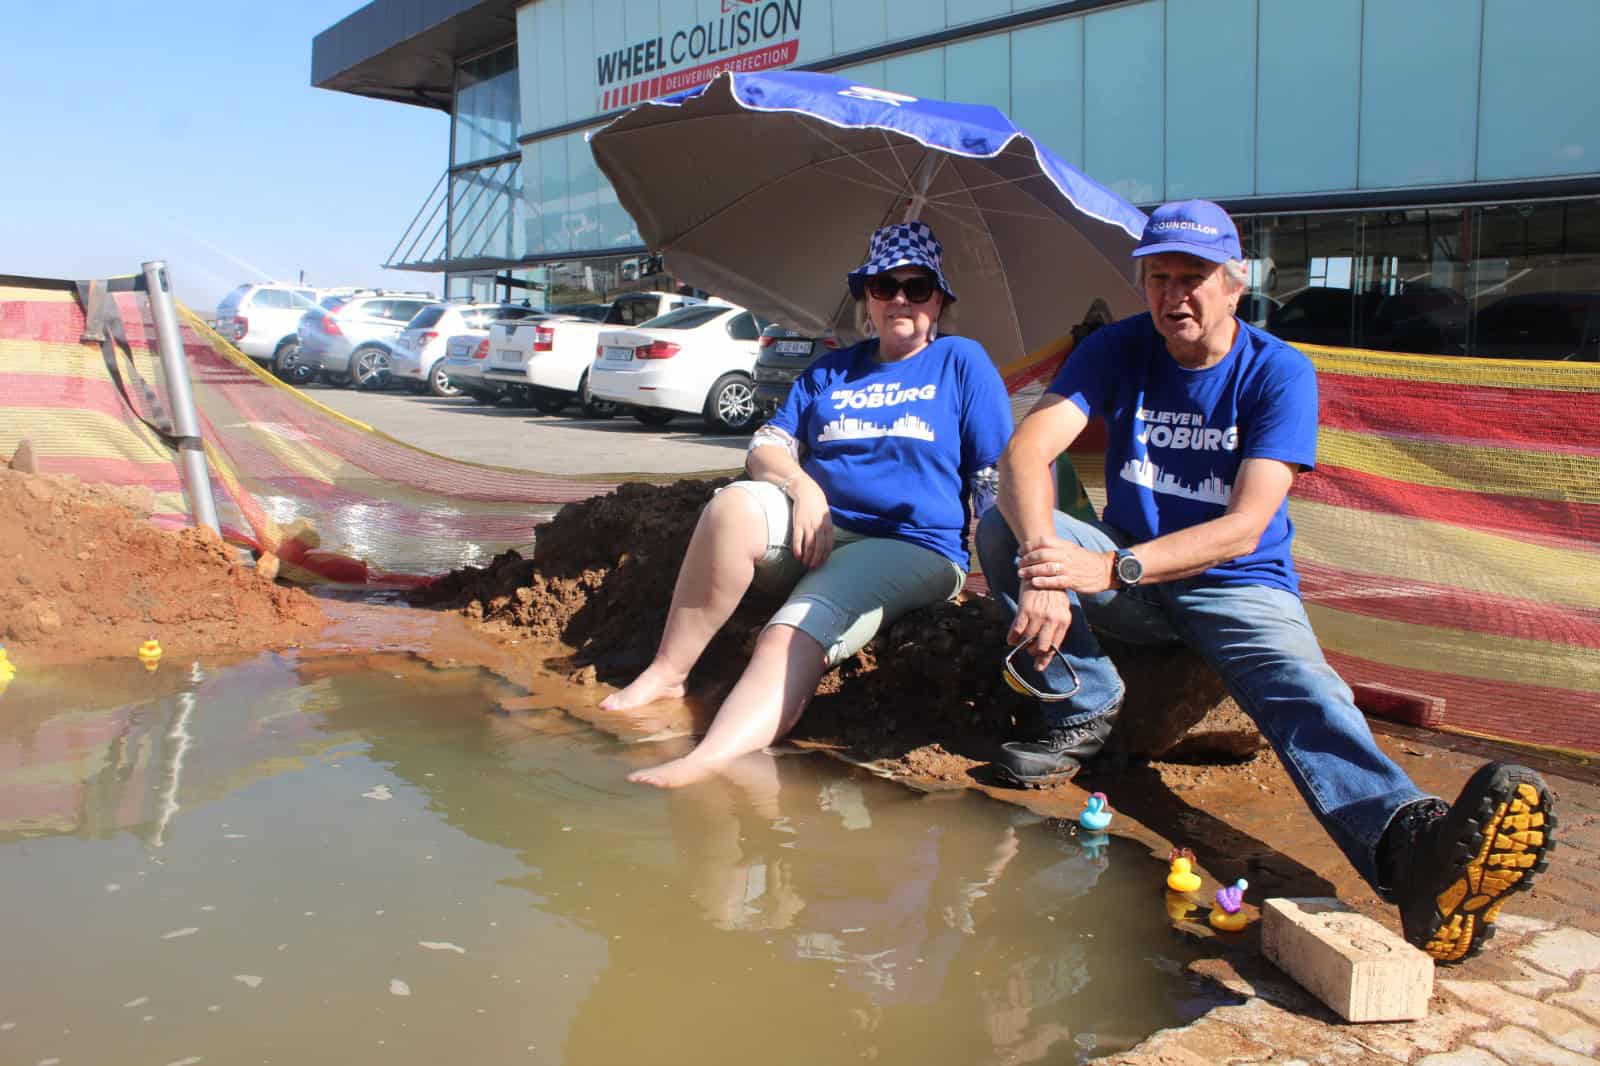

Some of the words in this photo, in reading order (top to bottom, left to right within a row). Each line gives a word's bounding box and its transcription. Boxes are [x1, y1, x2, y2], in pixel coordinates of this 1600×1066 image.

[597, 37, 667, 86] WHEEL
[670, 0, 801, 64] COLLISION
[665, 65, 721, 91] DELIVERING
[724, 47, 789, 73] PERFECTION
[833, 384, 937, 410] JOBURG
[886, 382, 901, 391] IN
[1191, 415, 1203, 427] IN
[1137, 424, 1238, 451] JOBURG
